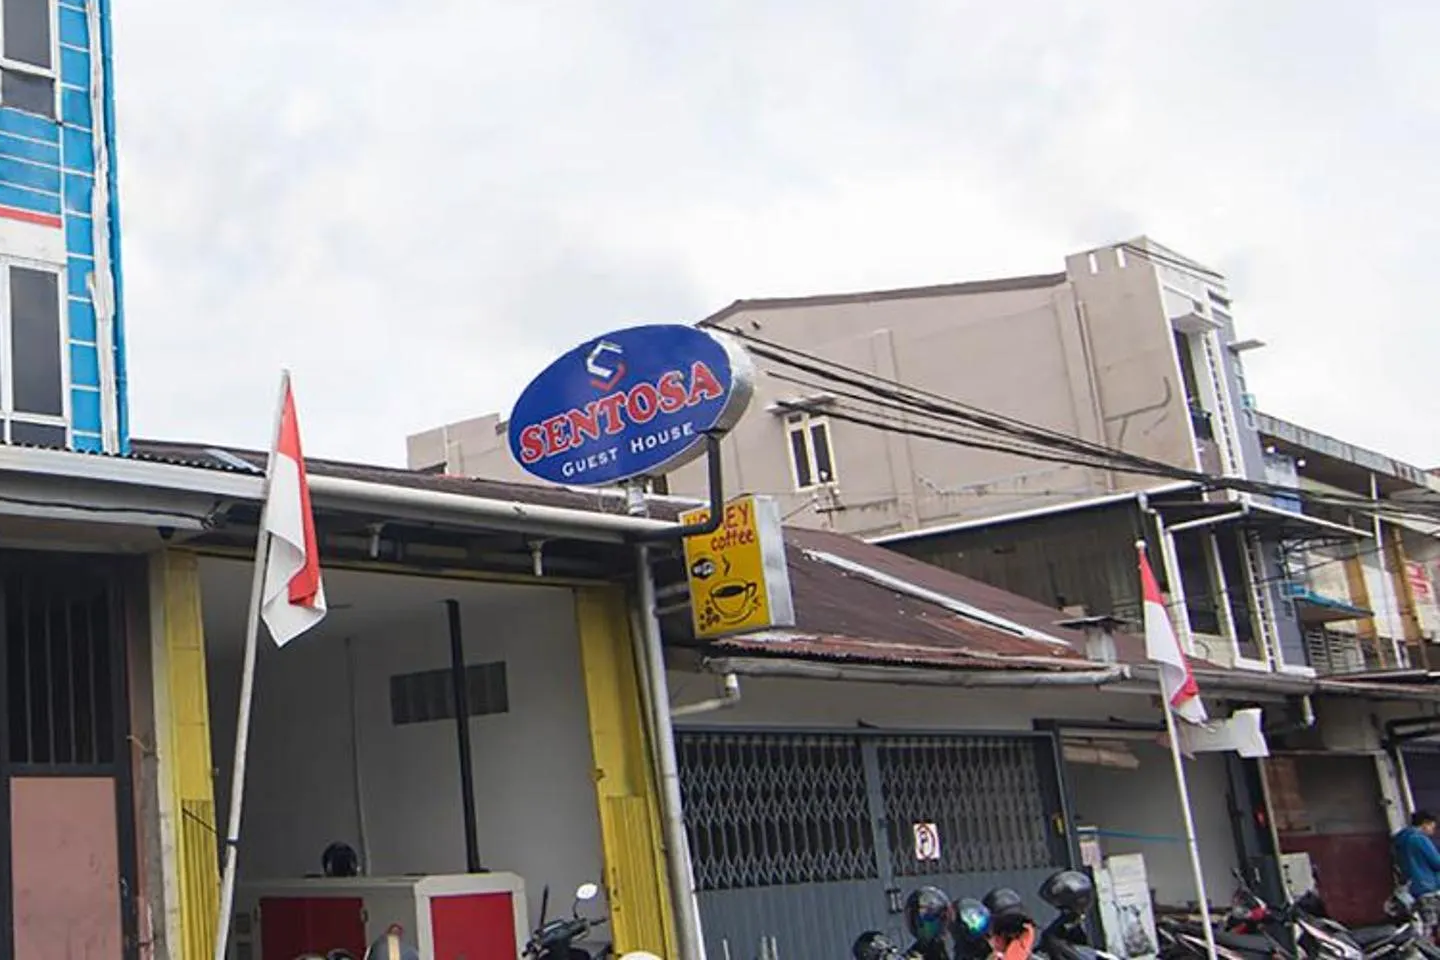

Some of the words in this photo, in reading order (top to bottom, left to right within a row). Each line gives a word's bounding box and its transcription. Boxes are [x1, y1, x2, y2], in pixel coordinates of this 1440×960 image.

[520, 361, 724, 464] SENTOSA
[561, 447, 619, 477] GUEST
[630, 422, 695, 455] HOUSE
